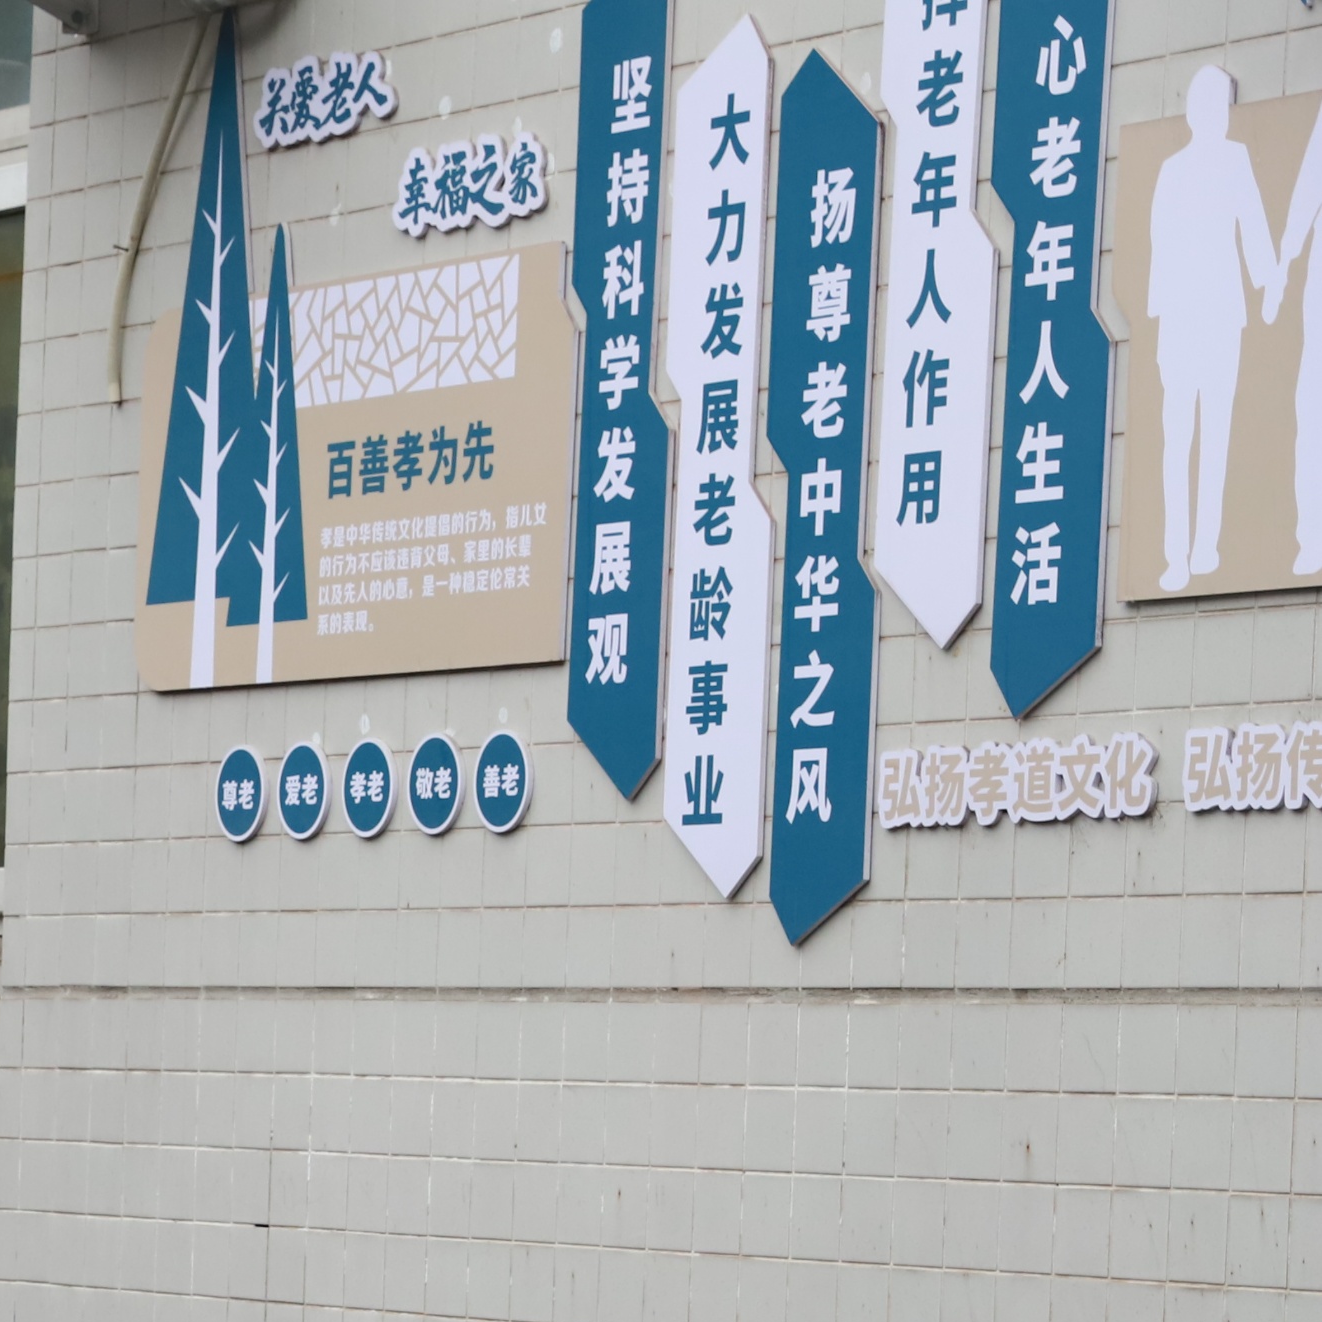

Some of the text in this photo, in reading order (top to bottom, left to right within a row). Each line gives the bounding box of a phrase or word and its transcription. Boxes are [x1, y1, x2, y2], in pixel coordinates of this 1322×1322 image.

[259, 60, 388, 136] 关爱老人
[398, 141, 539, 225] 幸福之家
[1011, 15, 1087, 605] 心老年人生活
[586, 55, 652, 685] 坚持科学发展观
[327, 420, 495, 499] 百善孝为先
[681, 91, 752, 827] 大力发展老龄事业
[785, 167, 857, 824] 扬尊老中华之风
[222, 779, 255, 811] 尊老
[285, 773, 319, 807] 爱老
[350, 770, 385, 804] 孝老
[415, 767, 452, 800] 敬老
[482, 763, 520, 799] 善老
[884, 739, 1149, 821] 弘扬孝道文化
